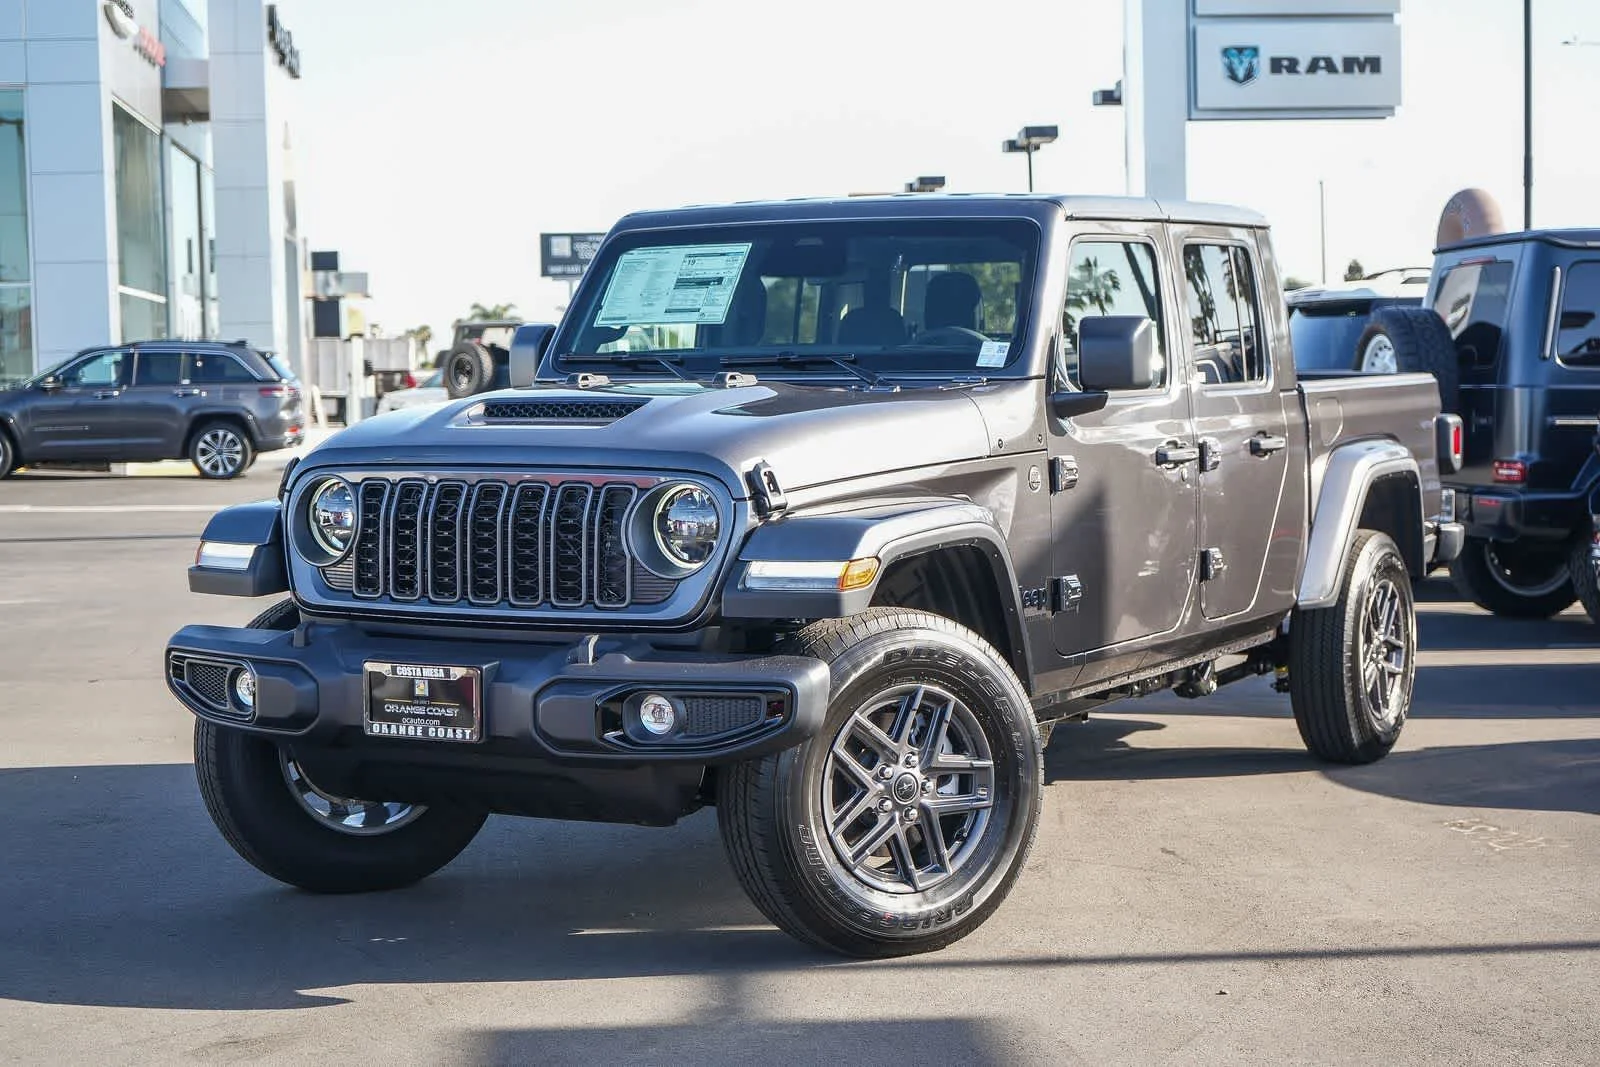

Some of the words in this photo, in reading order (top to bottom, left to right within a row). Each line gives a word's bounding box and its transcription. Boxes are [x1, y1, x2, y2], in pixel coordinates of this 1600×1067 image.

[1269, 56, 1382, 74] RAM
[1018, 585, 1047, 610] eep
[396, 666, 422, 677] COSTA
[422, 668, 445, 678] MESA
[384, 703, 426, 715] ORANGE
[426, 706, 460, 717] COAST
[401, 717, 441, 726] ocauto.com
[372, 723, 423, 736] ORANGE
[428, 727, 472, 740] COAST
